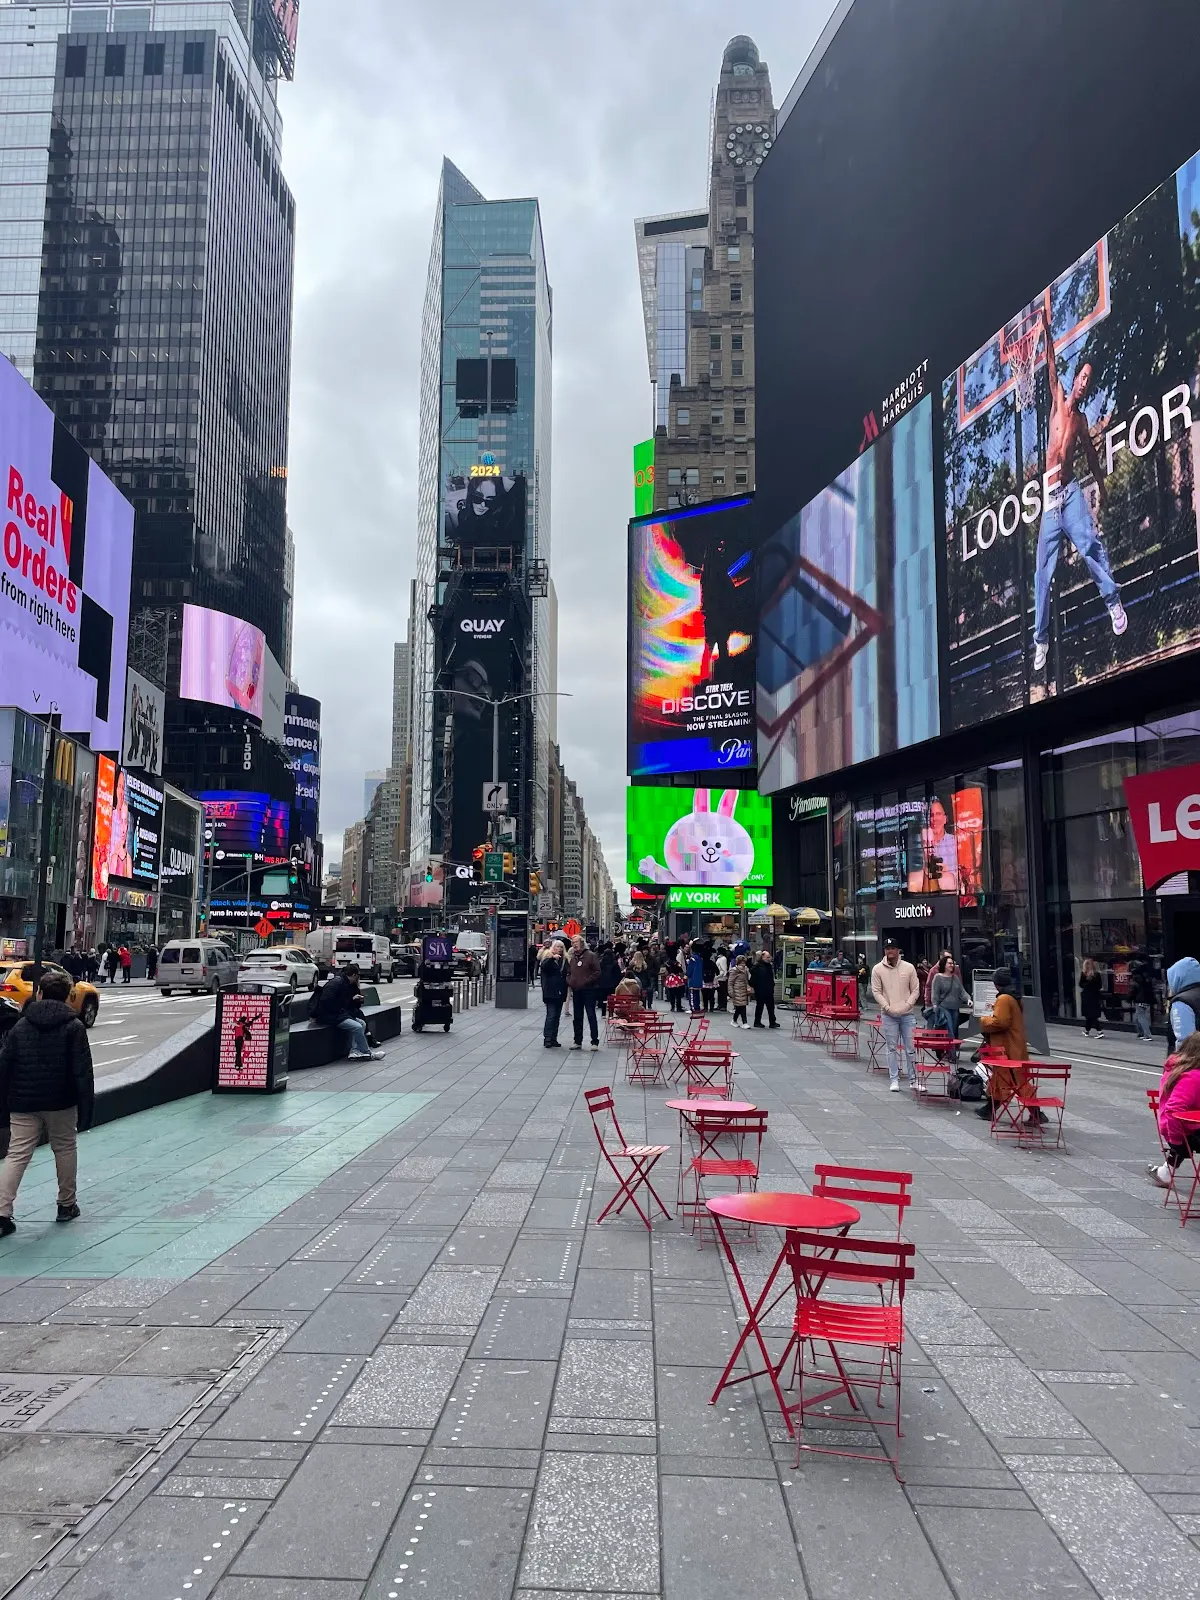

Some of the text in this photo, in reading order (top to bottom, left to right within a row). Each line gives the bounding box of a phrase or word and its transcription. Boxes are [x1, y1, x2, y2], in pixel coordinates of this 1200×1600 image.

[882, 358, 929, 411] MARRIOTT
[882, 381, 923, 427] MARQUIS
[470, 465, 500, 477] 2024
[961, 383, 1193, 562] LOOSE FOR
[7, 464, 57, 548] Real
[3, 521, 77, 614] Orders
[0, 570, 76, 643] from right here
[460, 619, 505, 633] QUAY
[705, 683, 734, 694] STAR TREK
[661, 690, 751, 714] DISCOVE
[686, 722, 706, 731] NOW
[243, 734, 252, 770] 1500
[717, 738, 752, 764] Par
[170, 847, 181, 870] OLD
[539, 902, 552, 910] 25
[686, 892, 721, 904] YORK
[894, 903, 927, 919] swatch
[0, 1377, 85, 1429] ELECTRICAL
